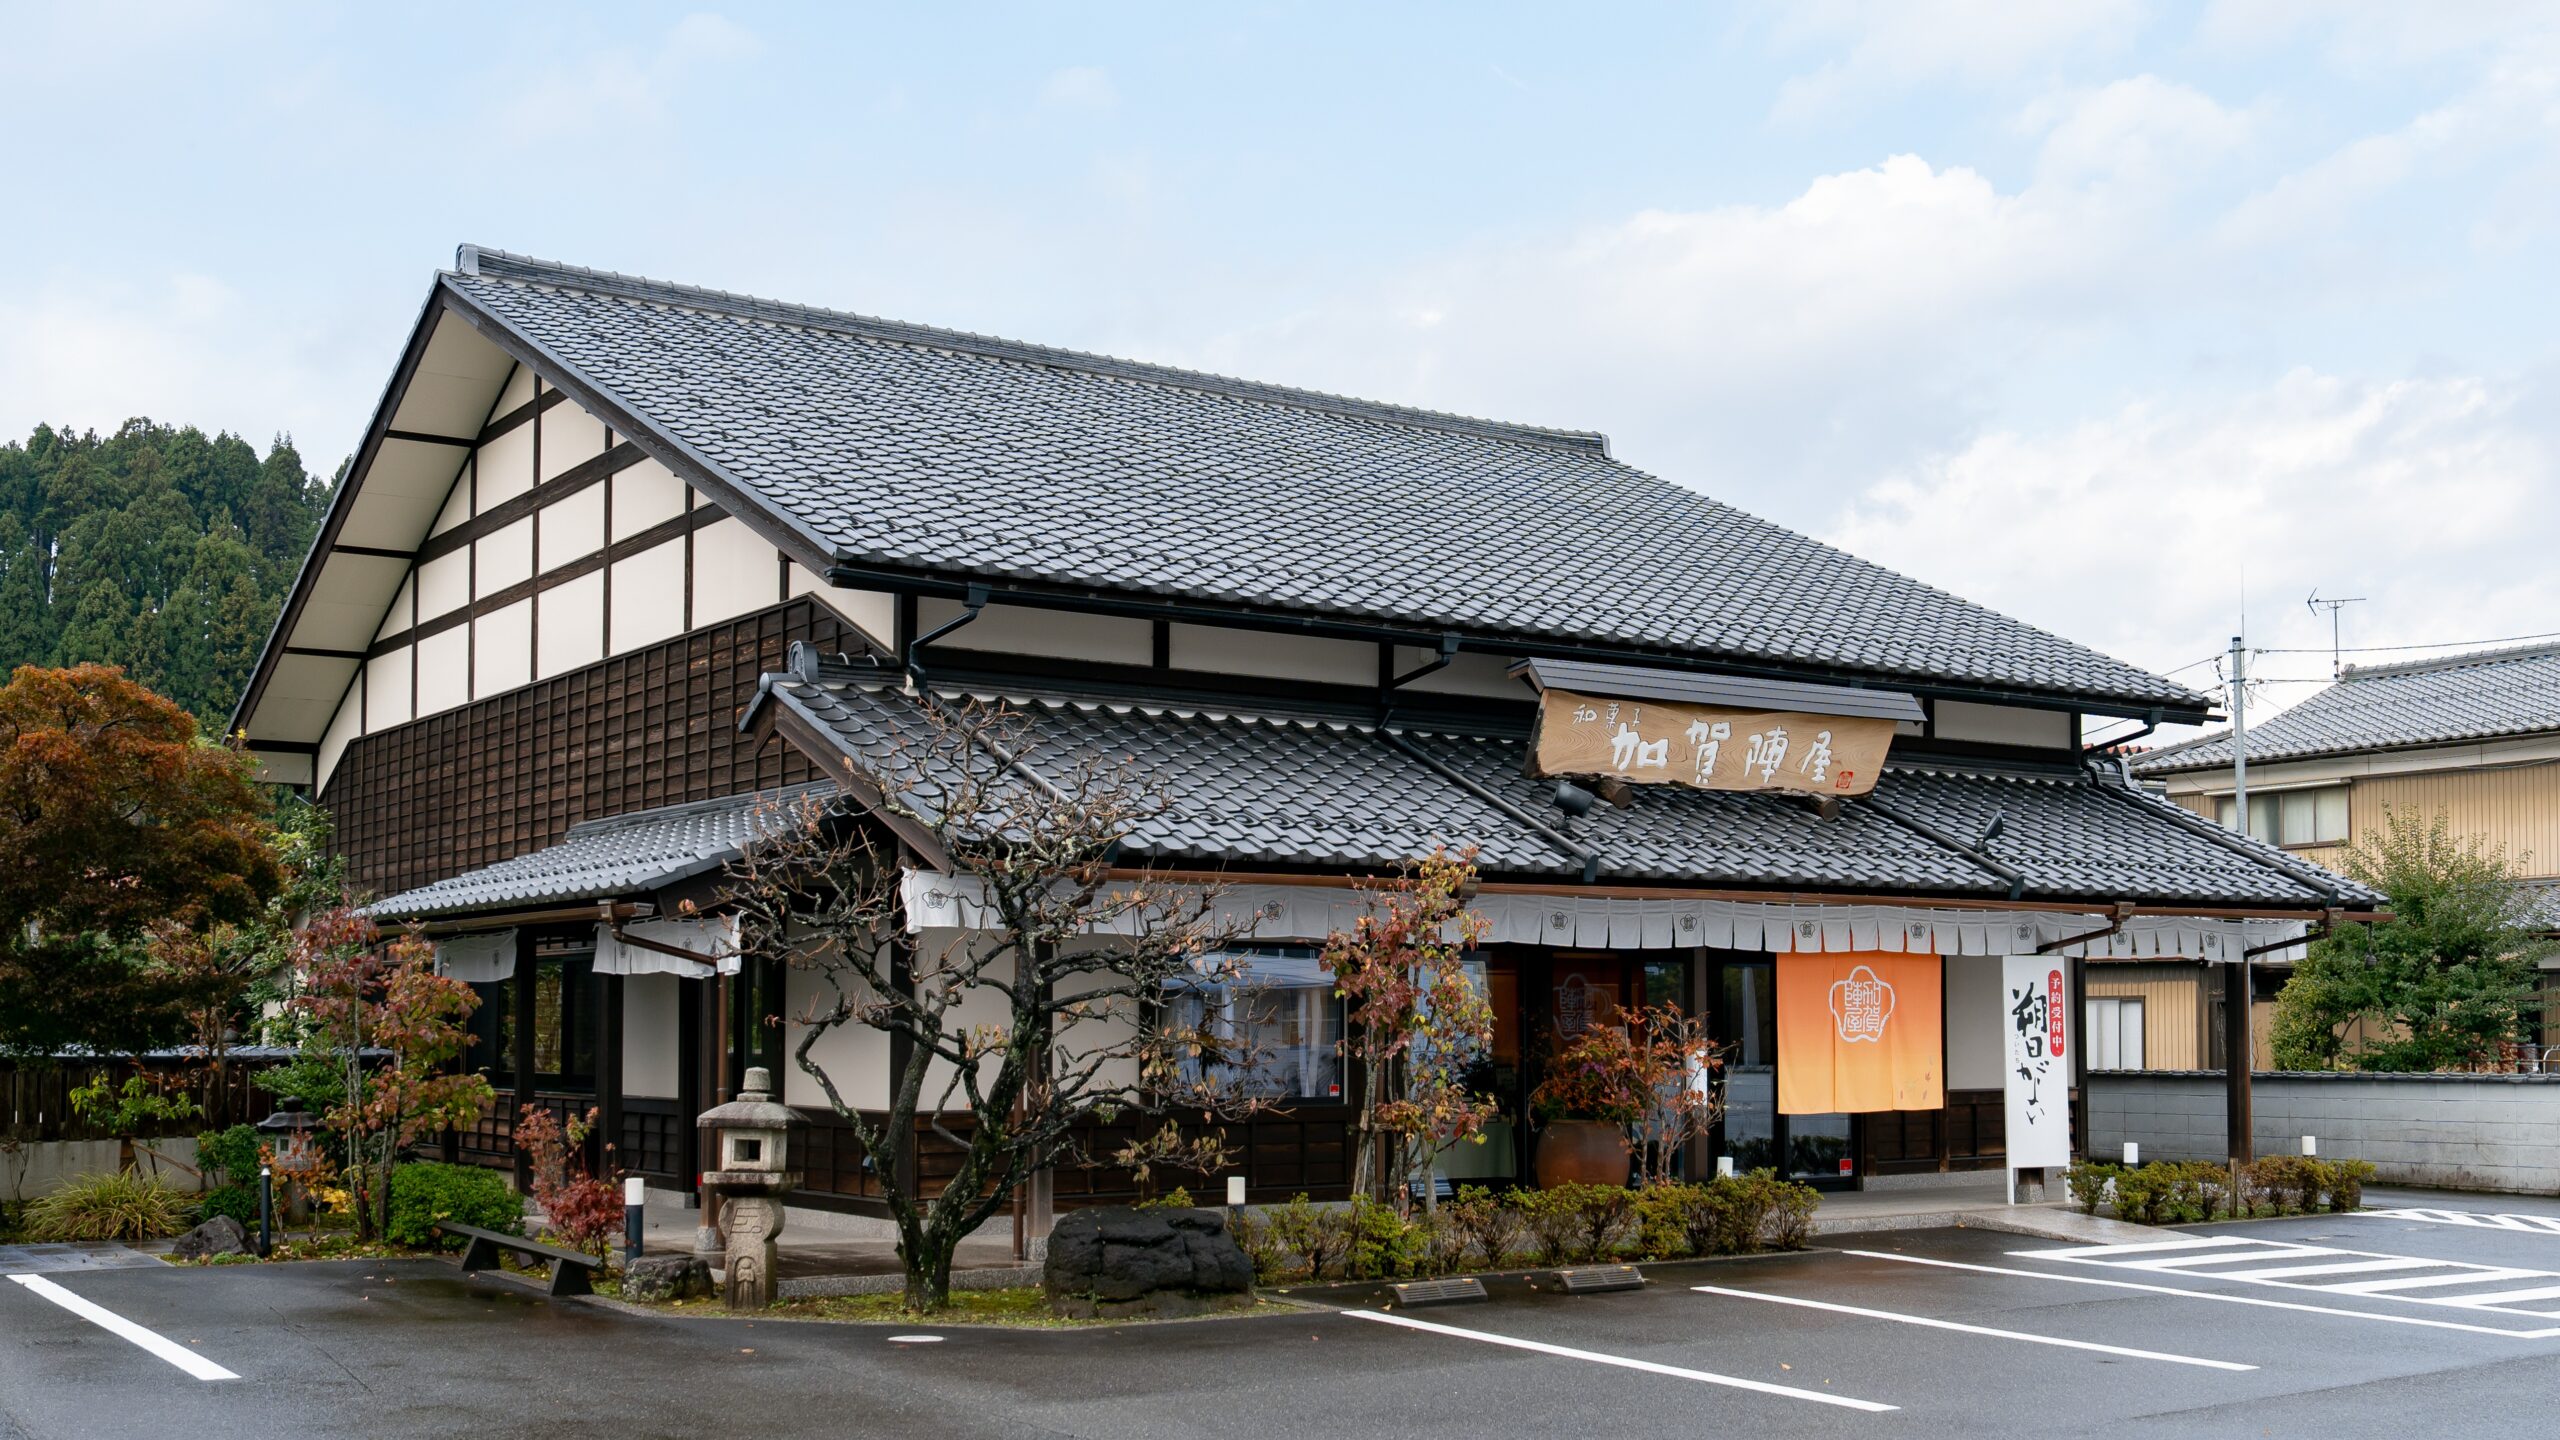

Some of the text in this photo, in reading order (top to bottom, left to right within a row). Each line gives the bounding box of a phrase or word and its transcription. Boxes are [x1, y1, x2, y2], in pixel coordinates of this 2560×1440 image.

[1573, 702, 1641, 728] 和菓子
[1609, 718, 1832, 784] 加賀陣屋
[2050, 977, 2063, 1048] 予約受付中
